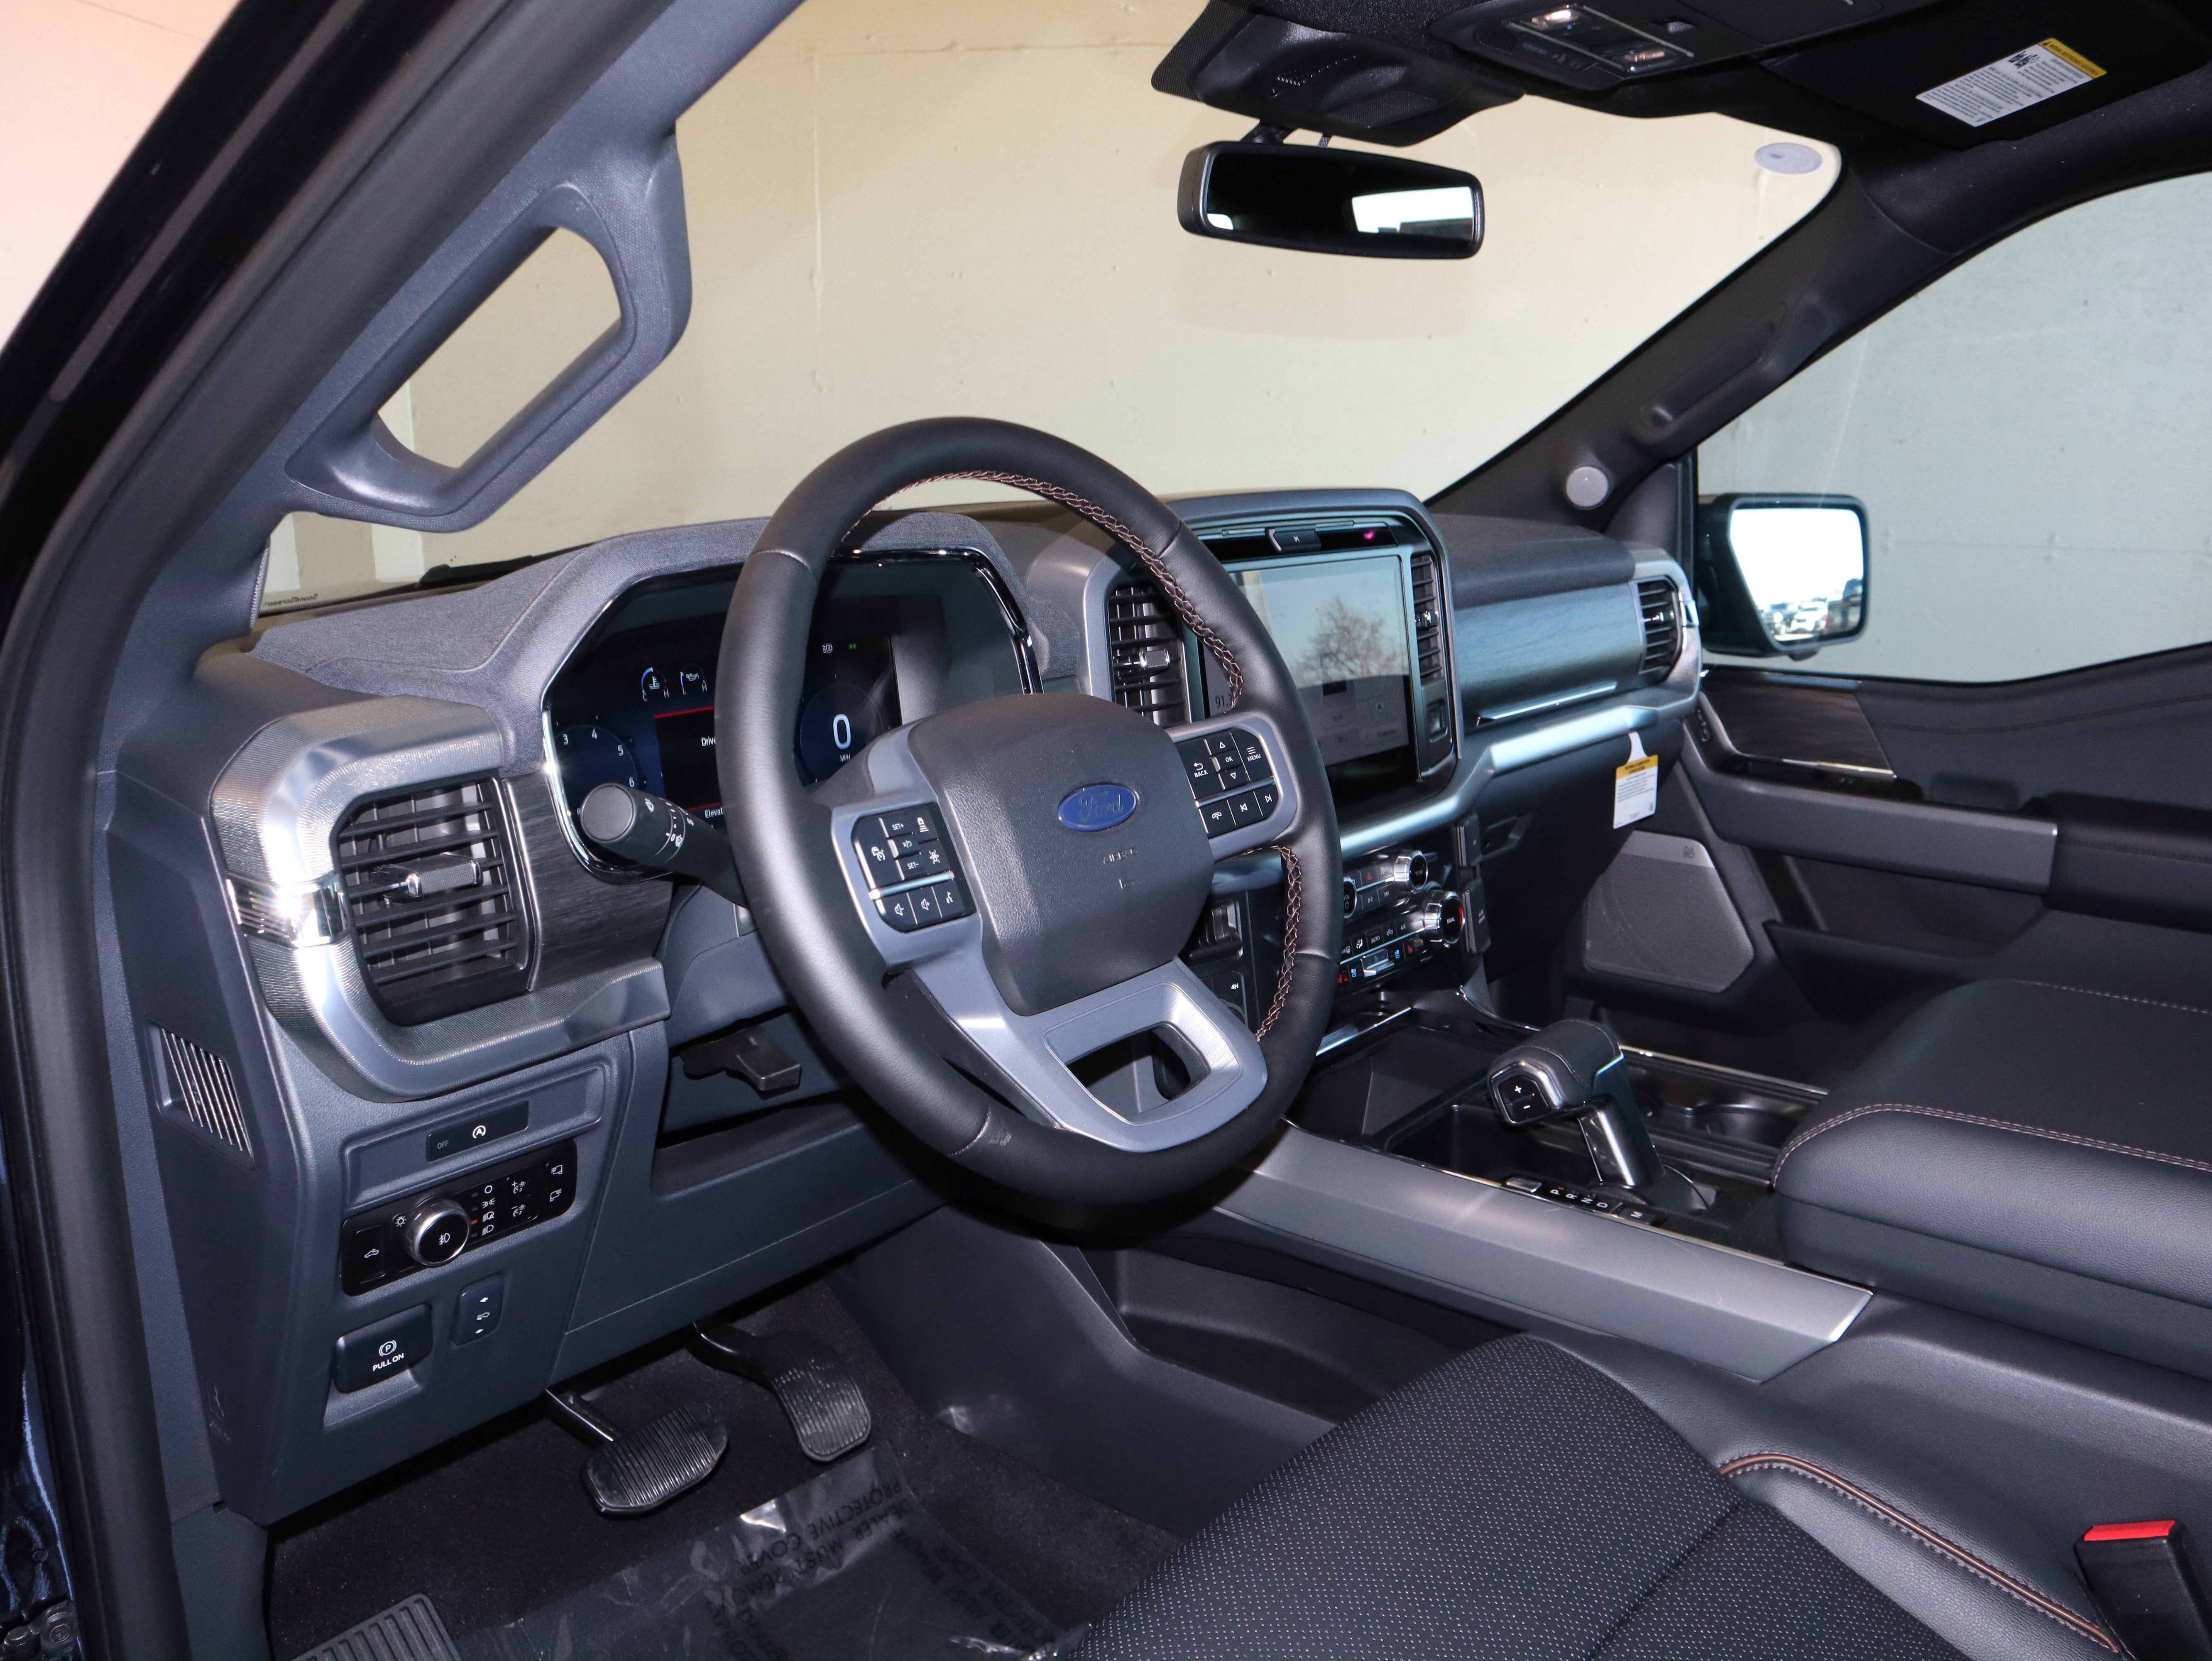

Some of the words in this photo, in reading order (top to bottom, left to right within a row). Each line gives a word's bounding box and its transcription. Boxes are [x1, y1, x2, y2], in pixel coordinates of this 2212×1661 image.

[663, 688, 669, 698] H
[1215, 694, 1232, 708] 91.3
[591, 728, 597, 740] 4
[833, 713, 851, 750] 0
[563, 733, 568, 745] 3
[617, 745, 624, 756] 5
[840, 753, 851, 762] MPH
[1194, 769, 1209, 778] BACK
[629, 777, 635, 788] 6
[705, 806, 723, 818] Elevat
[437, 1140, 449, 1149] OFF
[373, 1359, 392, 1372] PULL
[392, 1352, 404, 1362] ON
[809, 1477, 902, 1540] PROTECTIVE
[852, 1499, 914, 1542] DEALER
[793, 1537, 844, 1575] MUST
[978, 1582, 1055, 1644] ROTECTIVE
